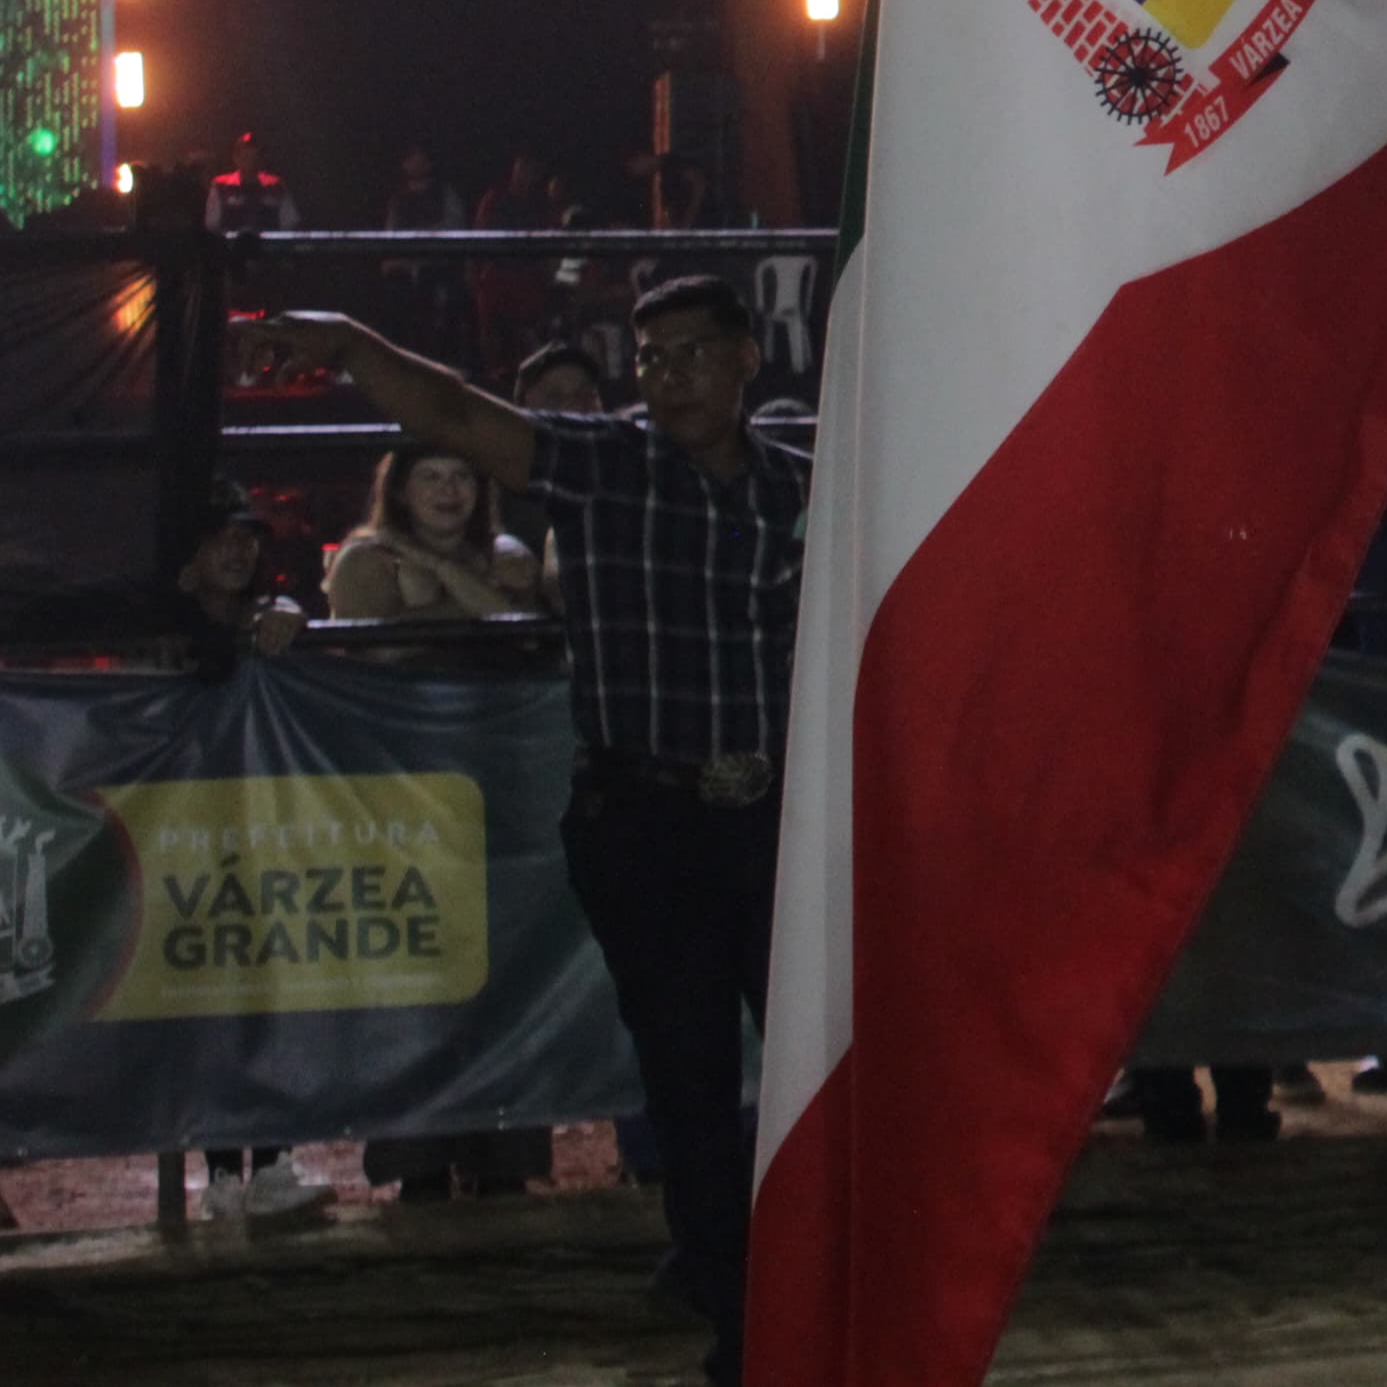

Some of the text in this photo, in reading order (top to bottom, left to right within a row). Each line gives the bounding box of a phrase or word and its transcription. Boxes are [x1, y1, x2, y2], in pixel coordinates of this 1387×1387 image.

[1183, 95, 1230, 148] 1867
[159, 820, 440, 854] PREFEITURA
[162, 853, 438, 919] VÁRZEA
[163, 916, 443, 970] GRANDE
